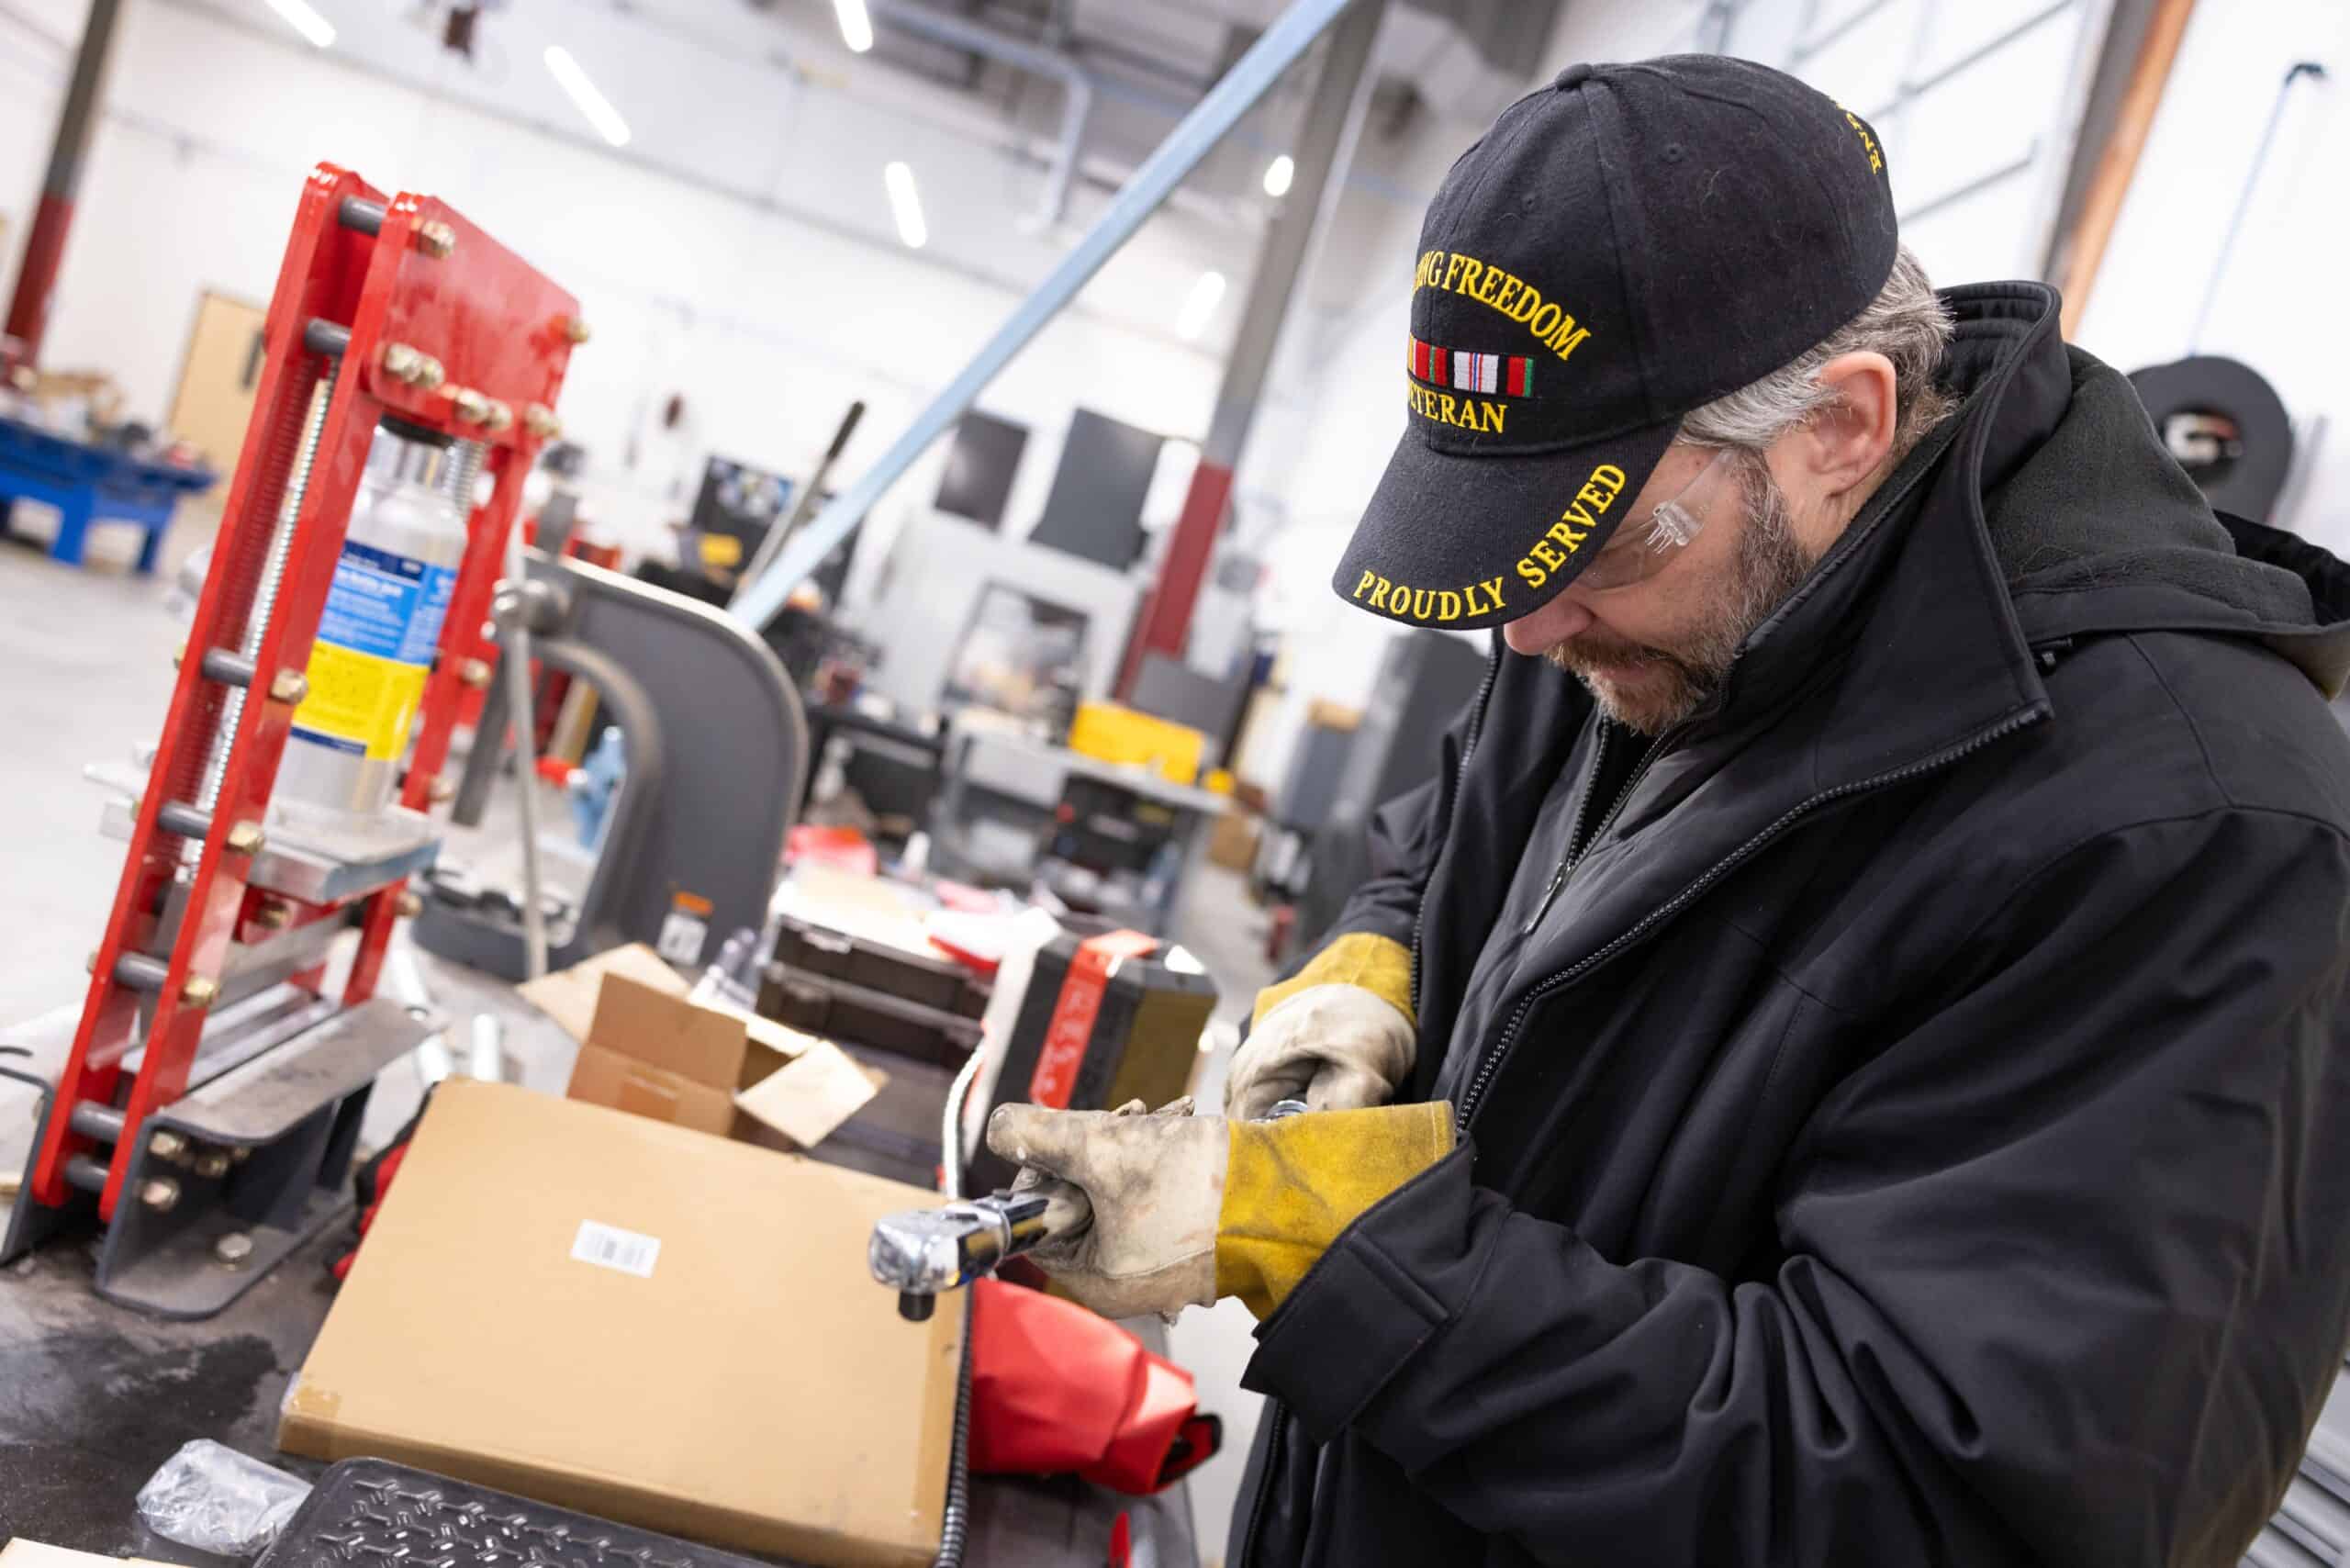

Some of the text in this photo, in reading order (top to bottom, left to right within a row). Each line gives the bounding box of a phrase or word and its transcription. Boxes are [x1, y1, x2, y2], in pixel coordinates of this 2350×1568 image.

[1441, 253, 1592, 362] FREEDOM
[1409, 379, 1508, 434] ETERAN
[1352, 463, 1628, 622] PROUDLY SERVED
